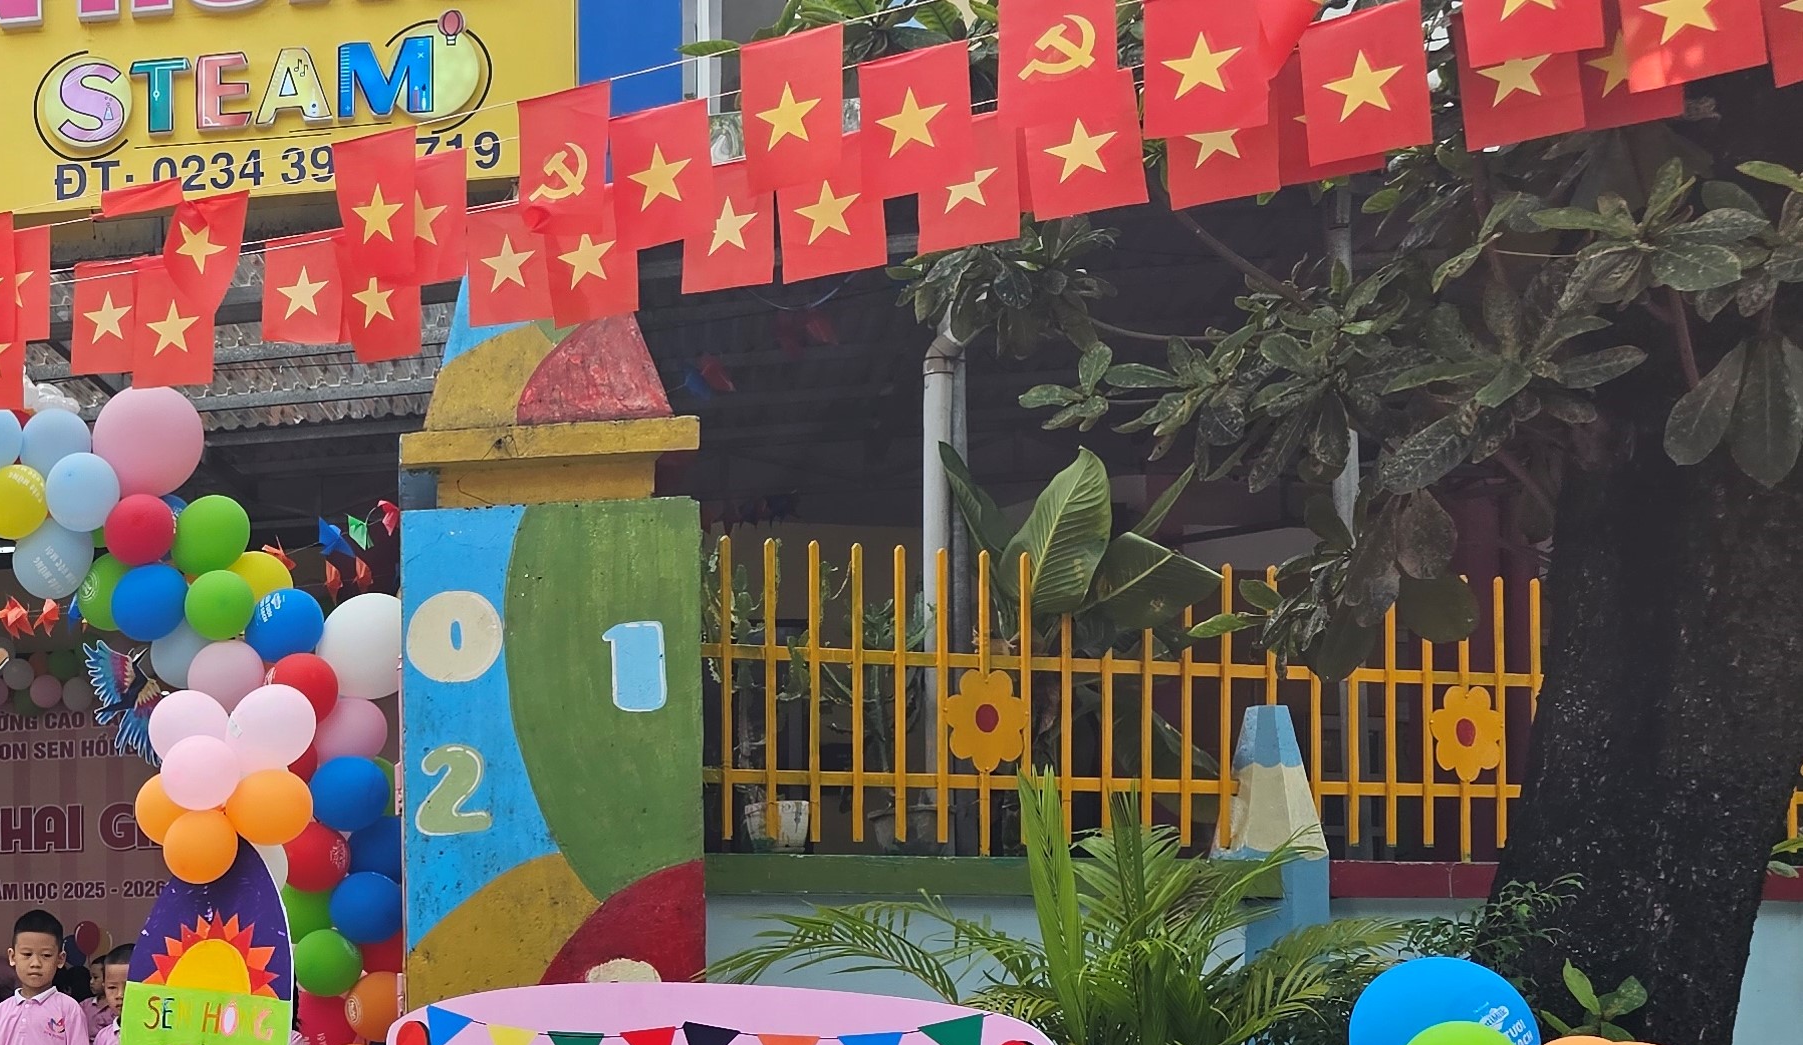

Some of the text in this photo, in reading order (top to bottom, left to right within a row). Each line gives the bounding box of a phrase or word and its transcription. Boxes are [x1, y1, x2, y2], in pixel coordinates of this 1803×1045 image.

[60, 36, 435, 144] STEAM
[601, 619, 667, 712] 1
[45, 711, 86, 731] CAO
[34, 741, 78, 761] SEN
[415, 744, 493, 836] 2
[24, 882, 58, 905] HỌC
[64, 881, 106, 899] 2025
